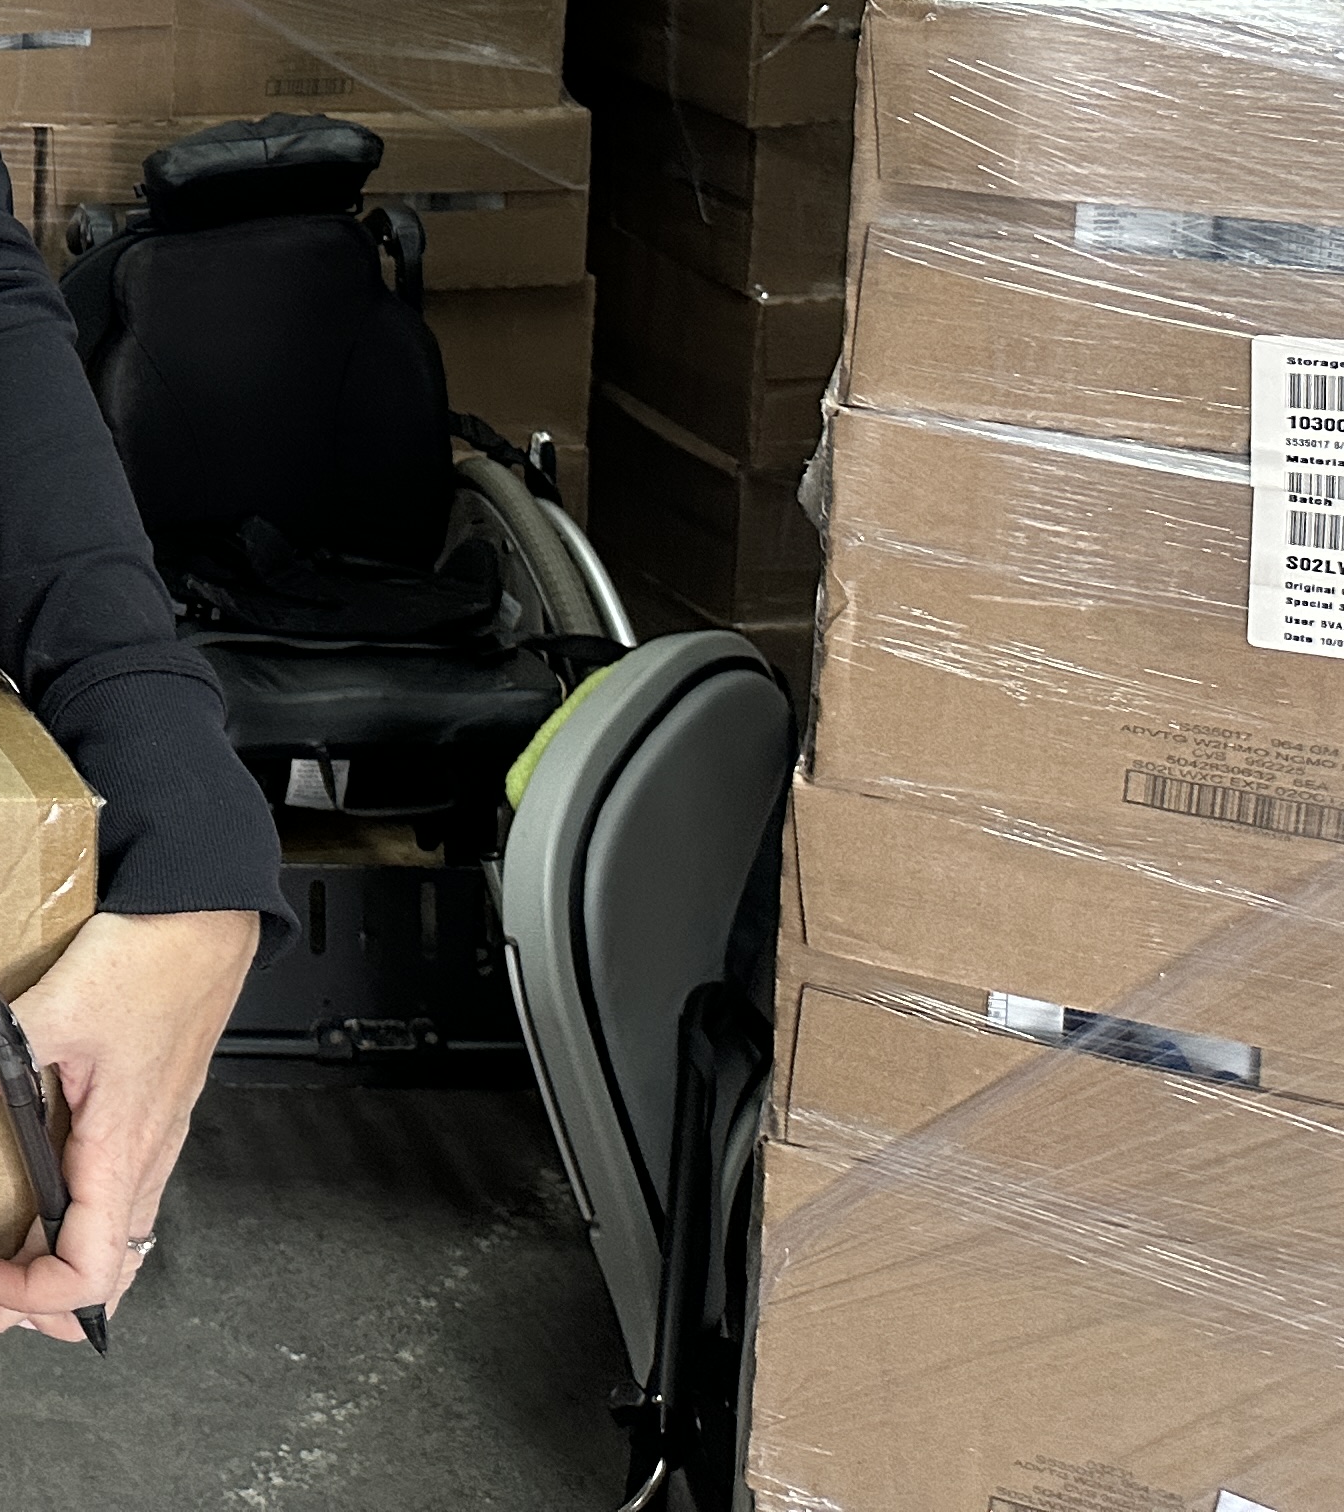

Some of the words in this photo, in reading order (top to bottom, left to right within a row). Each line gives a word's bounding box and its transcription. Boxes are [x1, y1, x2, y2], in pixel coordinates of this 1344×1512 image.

[1288, 494, 1333, 507] Batch
[1285, 581, 1335, 594] Original
[1285, 597, 1332, 609] Special
[1285, 615, 1315, 626] User
[1284, 632, 1313, 643] Date
[1192, 748, 1226, 761] CVS
[1230, 777, 1269, 790] EXP
